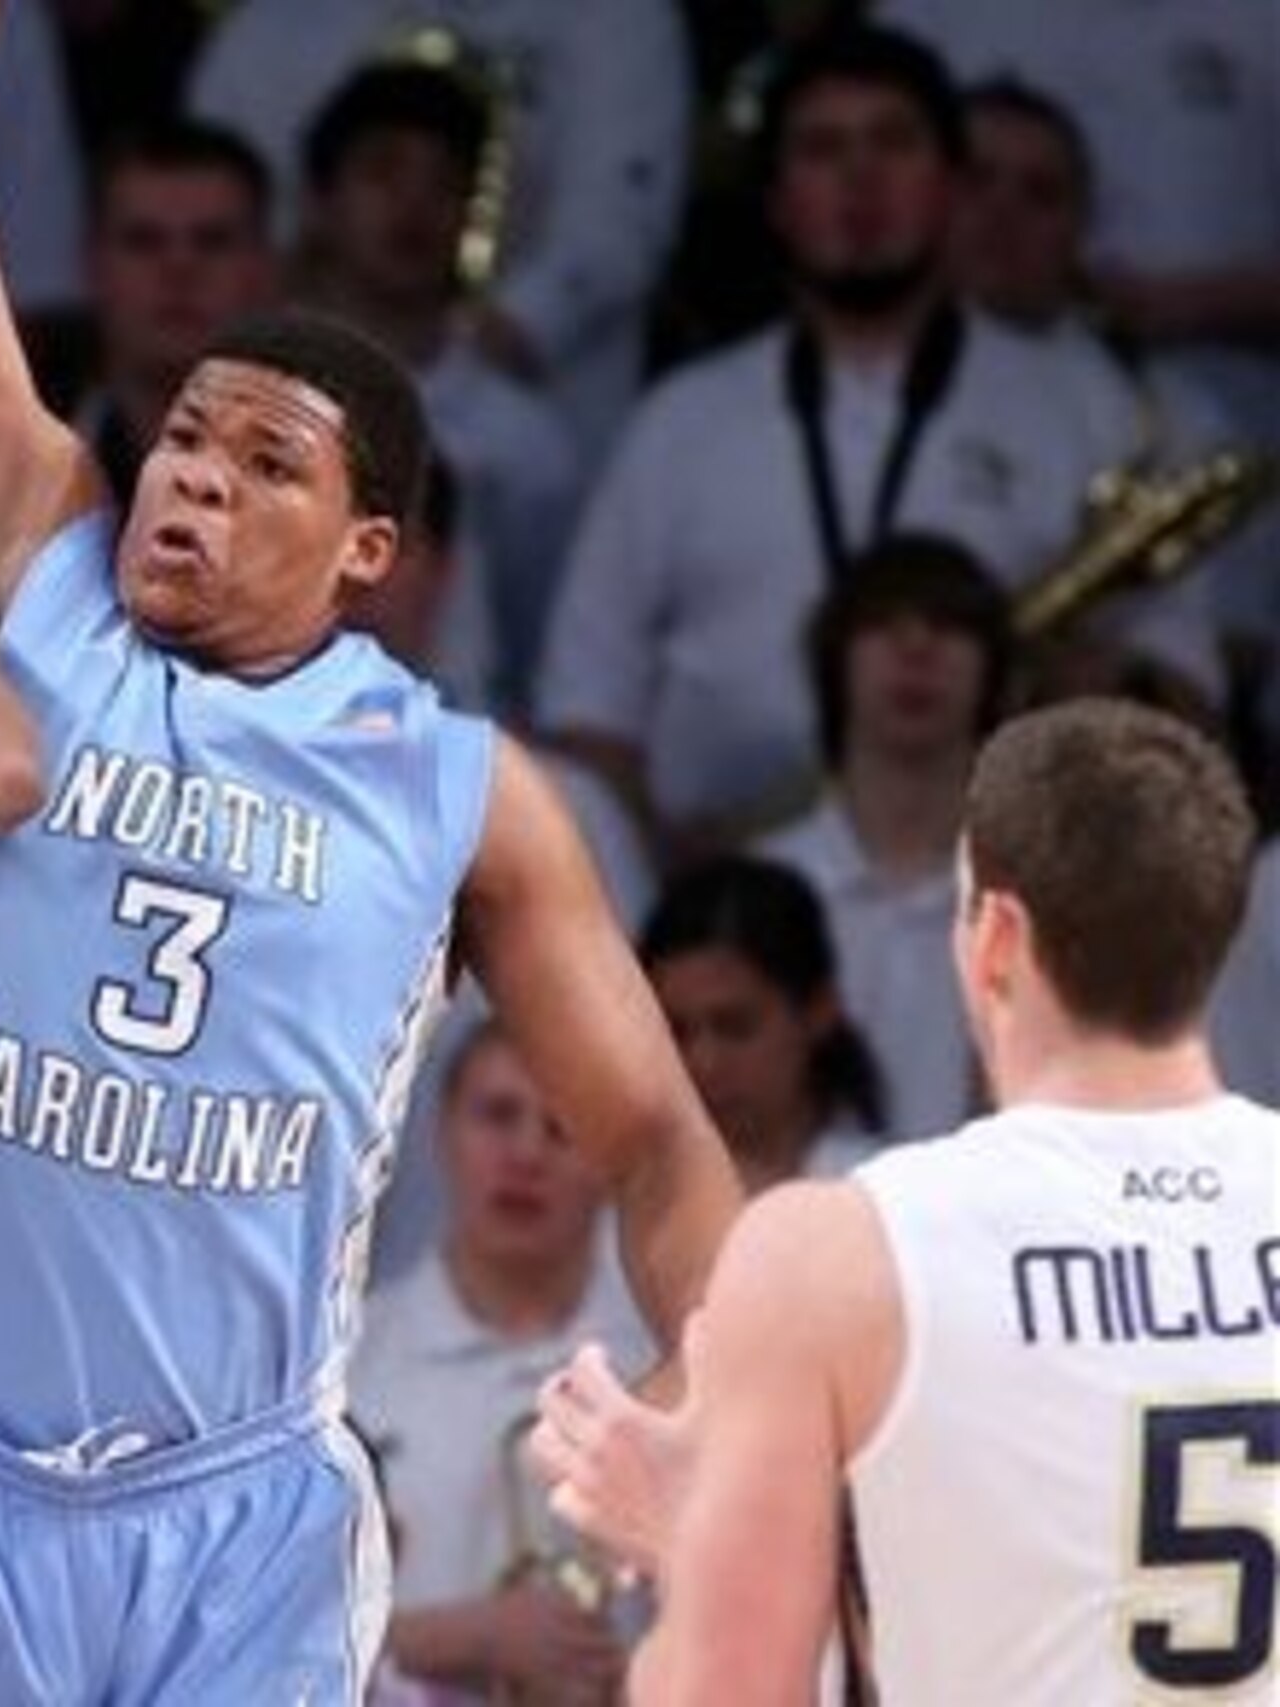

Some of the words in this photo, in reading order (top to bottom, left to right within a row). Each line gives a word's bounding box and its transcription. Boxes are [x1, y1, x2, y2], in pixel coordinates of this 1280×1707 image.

[48, 747, 326, 903] NORTH
[90, 871, 237, 1058] 3
[1121, 1166, 1223, 1202] ACC
[1128, 1400, 1280, 1690] 5
